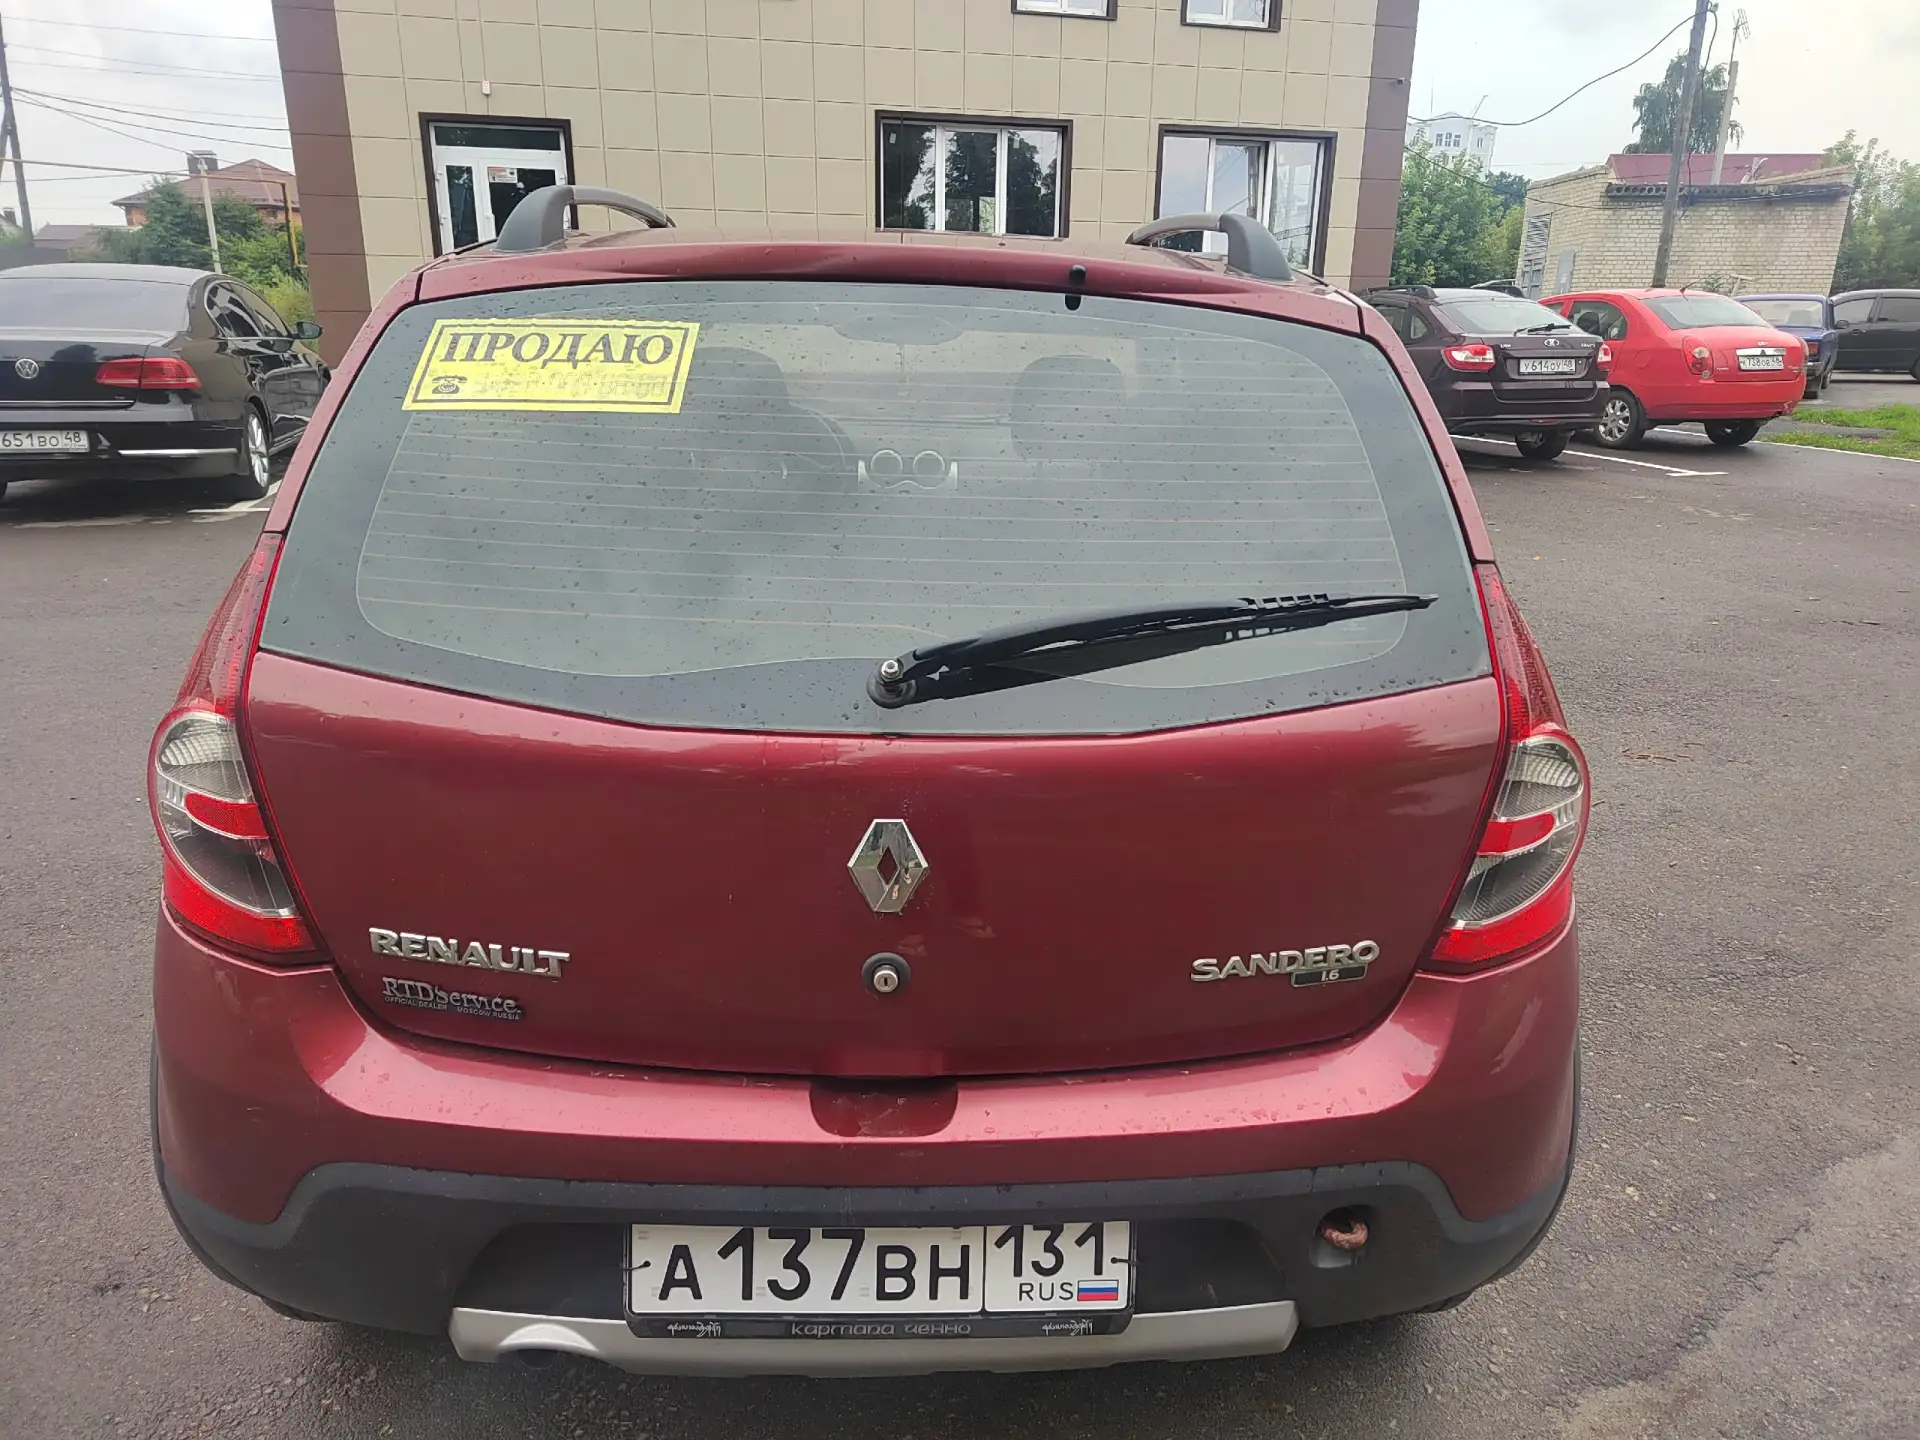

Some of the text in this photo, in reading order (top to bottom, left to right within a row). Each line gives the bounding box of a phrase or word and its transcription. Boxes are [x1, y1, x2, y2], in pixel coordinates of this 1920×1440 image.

[439, 331, 674, 370] ПРОДАЮ
[64, 431, 82, 444] 48
[369, 927, 571, 978] RENAULT
[1190, 940, 1380, 982] SANDERO
[1320, 969, 1341, 982] 1.6
[419, 1000, 448, 1011] DEALER
[492, 1011, 521, 1021] RUSSIA
[993, 1222, 1104, 1278] 131
[1018, 1280, 1074, 1302] RUS
